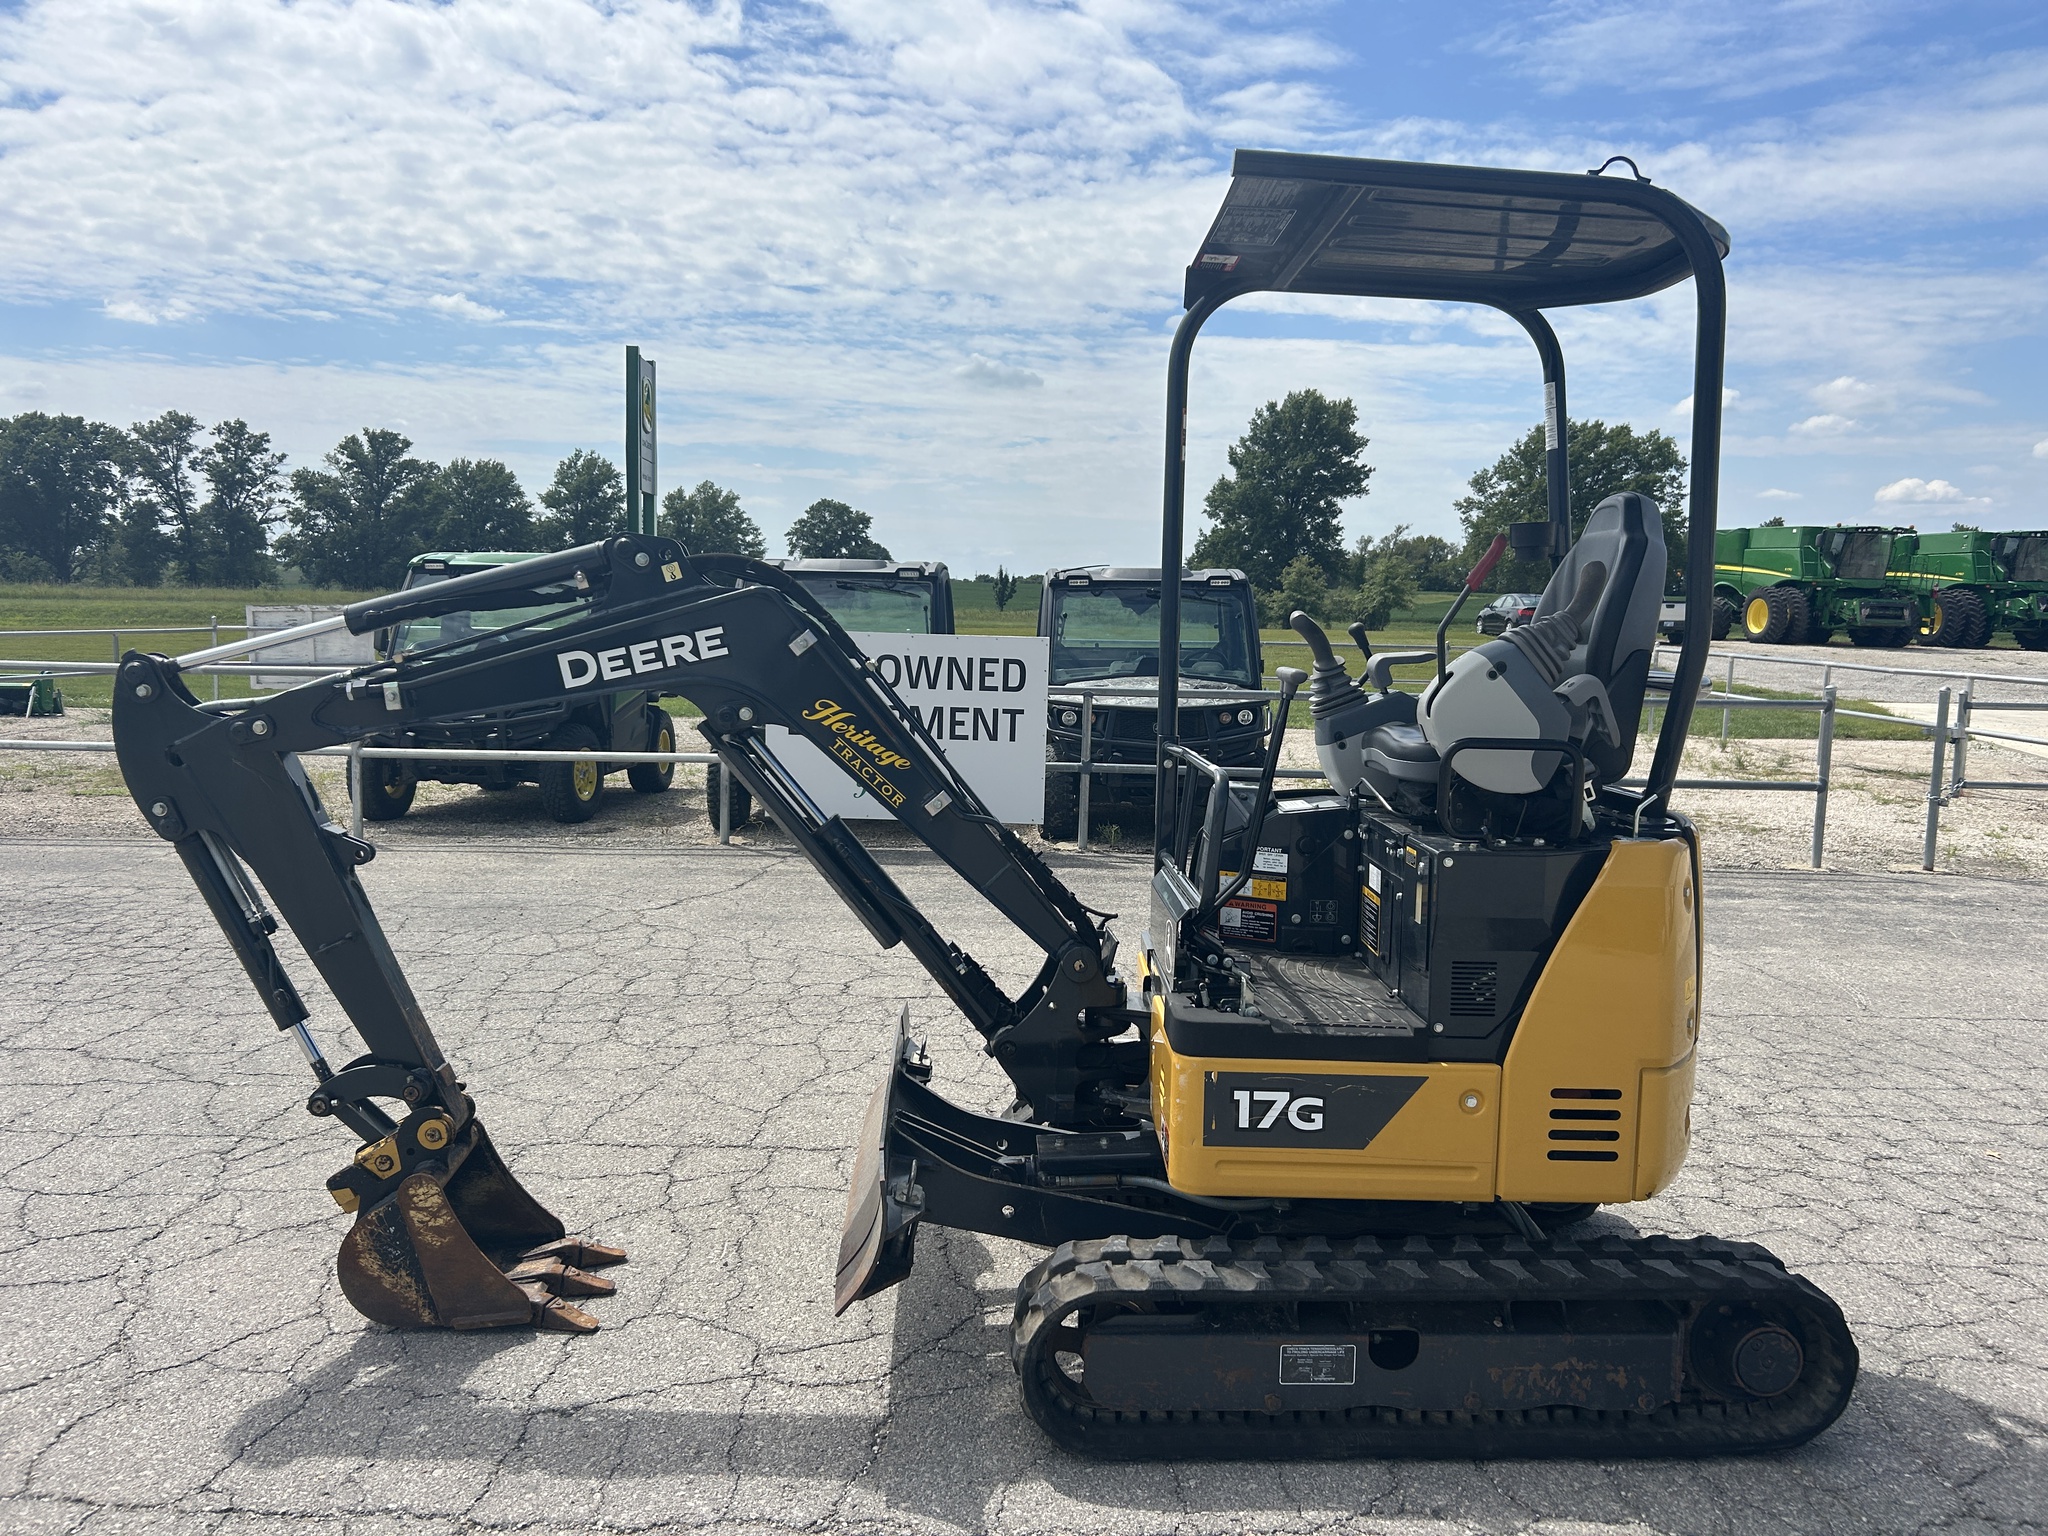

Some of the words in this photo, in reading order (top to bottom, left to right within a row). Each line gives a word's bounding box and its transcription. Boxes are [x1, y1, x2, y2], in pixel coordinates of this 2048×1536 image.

[556, 626, 729, 689] DEERE
[876, 653, 1027, 692] OWNED
[801, 699, 911, 770] Heritage
[832, 738, 904, 807] TRACTOR
[1256, 846, 1282, 854] PORTANT
[1234, 901, 1267, 910] WARNING
[1233, 1090, 1324, 1131] 17G
